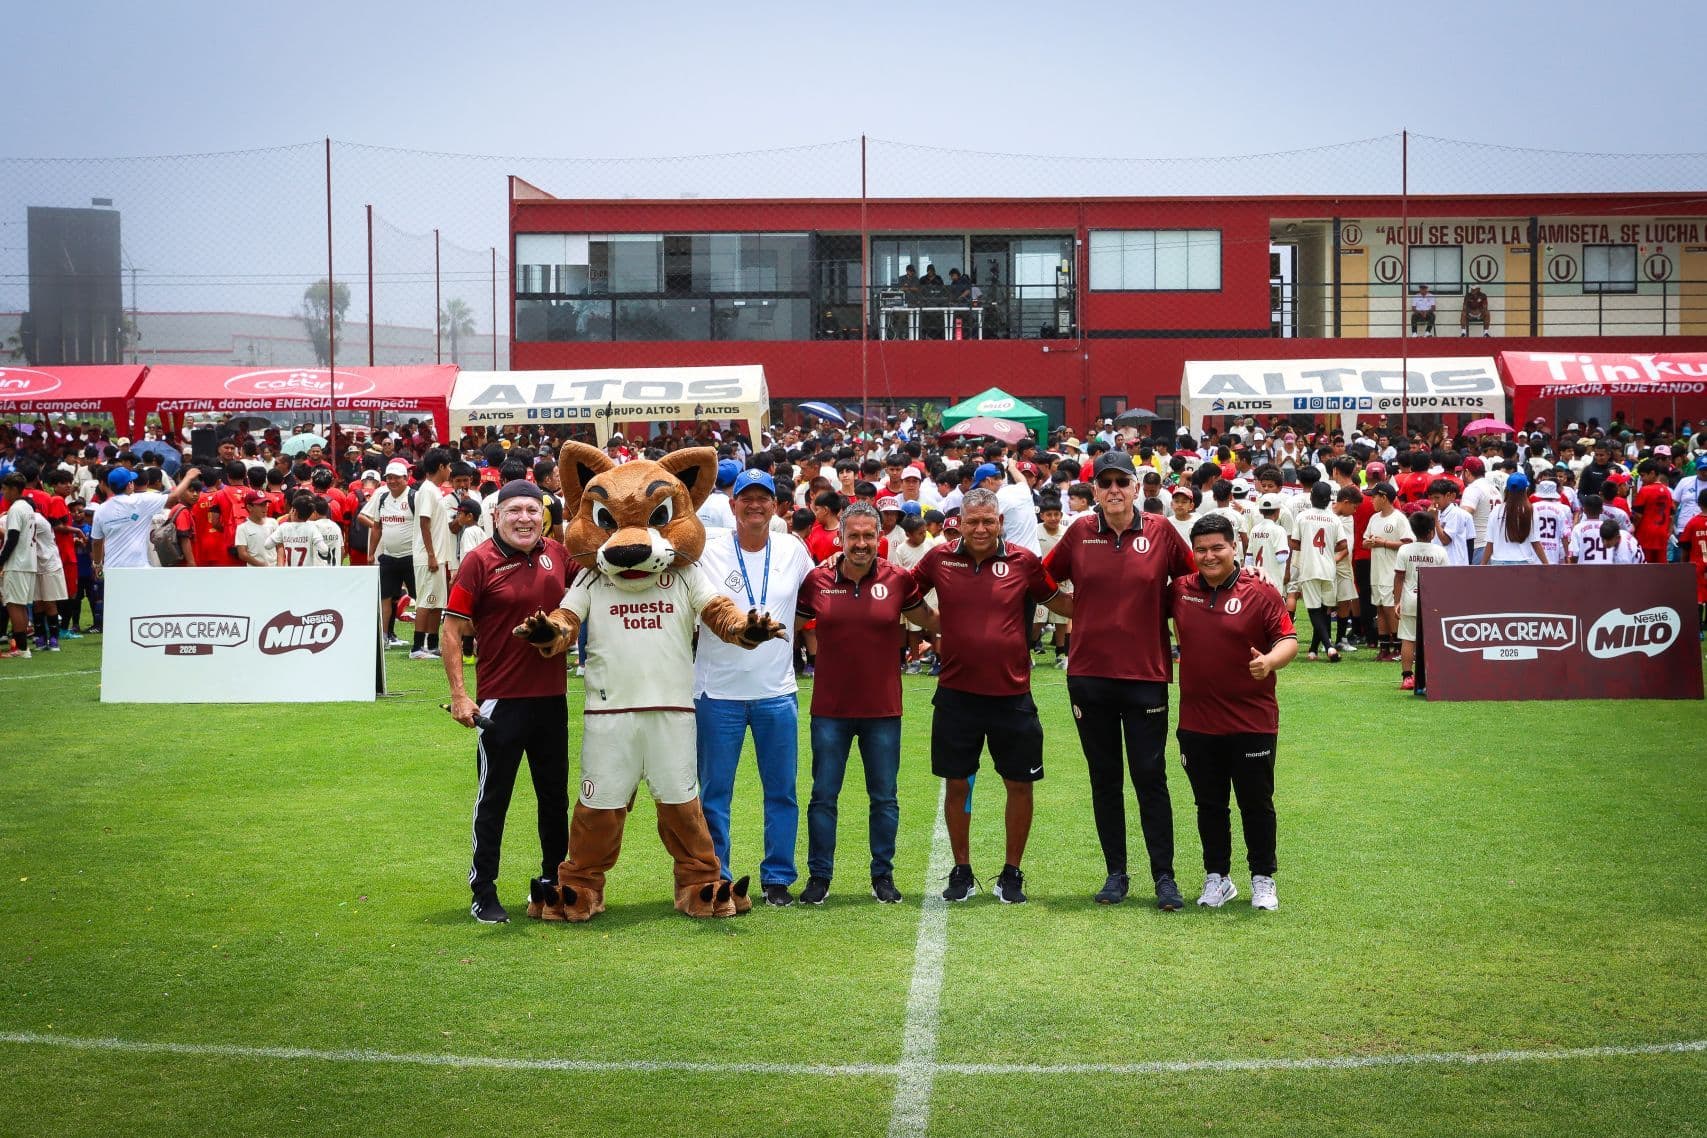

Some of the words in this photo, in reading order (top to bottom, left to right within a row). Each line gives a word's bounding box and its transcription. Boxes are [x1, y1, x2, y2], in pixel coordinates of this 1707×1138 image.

[1428, 225, 1449, 244] SE
[1502, 225, 1521, 244] LA
[1620, 223, 1641, 243] SE
[1645, 223, 1700, 242] LUCHA
[1197, 368, 1496, 395] ALTOS
[1610, 381, 1705, 393] SUJETANDO
[467, 378, 743, 405] ALTOS
[36, 400, 102, 412] campeón!
[218, 398, 273, 410] dándole
[336, 396, 350, 408] al
[352, 398, 419, 411] campeón!
[646, 405, 681, 415] ALTOS
[705, 406, 740, 414] ALTOS
[1227, 400, 1273, 410] ALTOS
[1441, 397, 1483, 407] ALTOS
[480, 411, 514, 420] ALTOS
[1539, 516, 1556, 539] 23
[284, 546, 308, 567] 17
[1583, 536, 1608, 561] 24
[609, 600, 674, 618] apuesta
[623, 614, 663, 630] total
[1633, 612, 1669, 625] Nestlé
[137, 622, 184, 639] COPA
[186, 621, 241, 639] CREMA
[263, 622, 336, 649] MILO
[1451, 622, 1503, 642] COPA
[1504, 621, 1568, 641] CREMA
[1594, 621, 1673, 651] MILO
[179, 645, 197, 654] 2026
[1500, 648, 1519, 658] 2026
